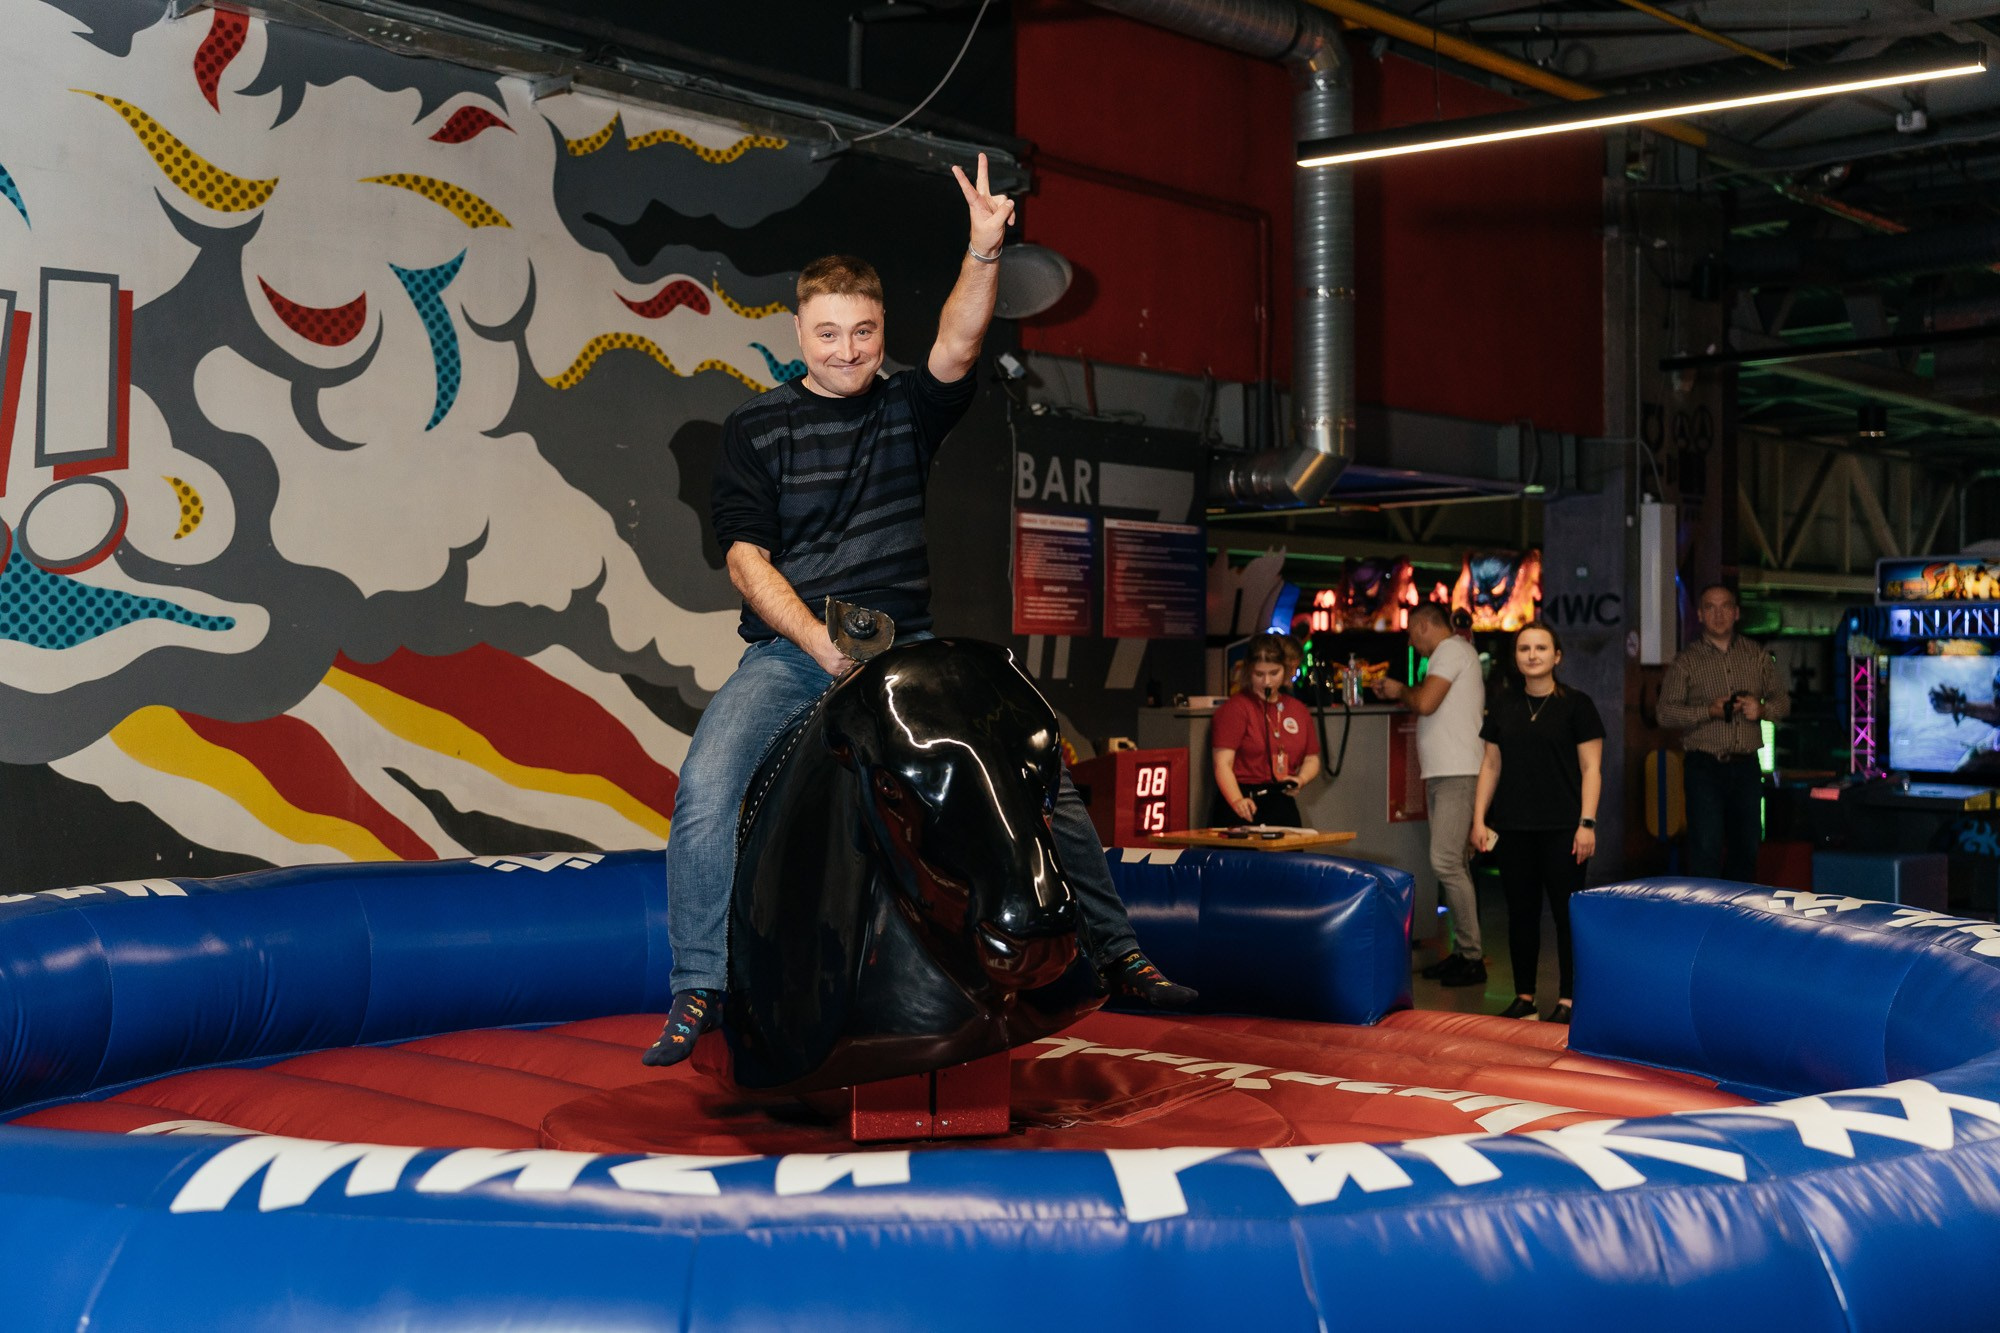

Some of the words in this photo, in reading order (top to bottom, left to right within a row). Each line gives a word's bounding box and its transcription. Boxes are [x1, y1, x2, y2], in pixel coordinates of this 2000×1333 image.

[1017, 452, 1092, 505] BAR
[1562, 594, 1621, 626] WC
[1136, 767, 1168, 797] 08
[1143, 801, 1166, 830] 15
